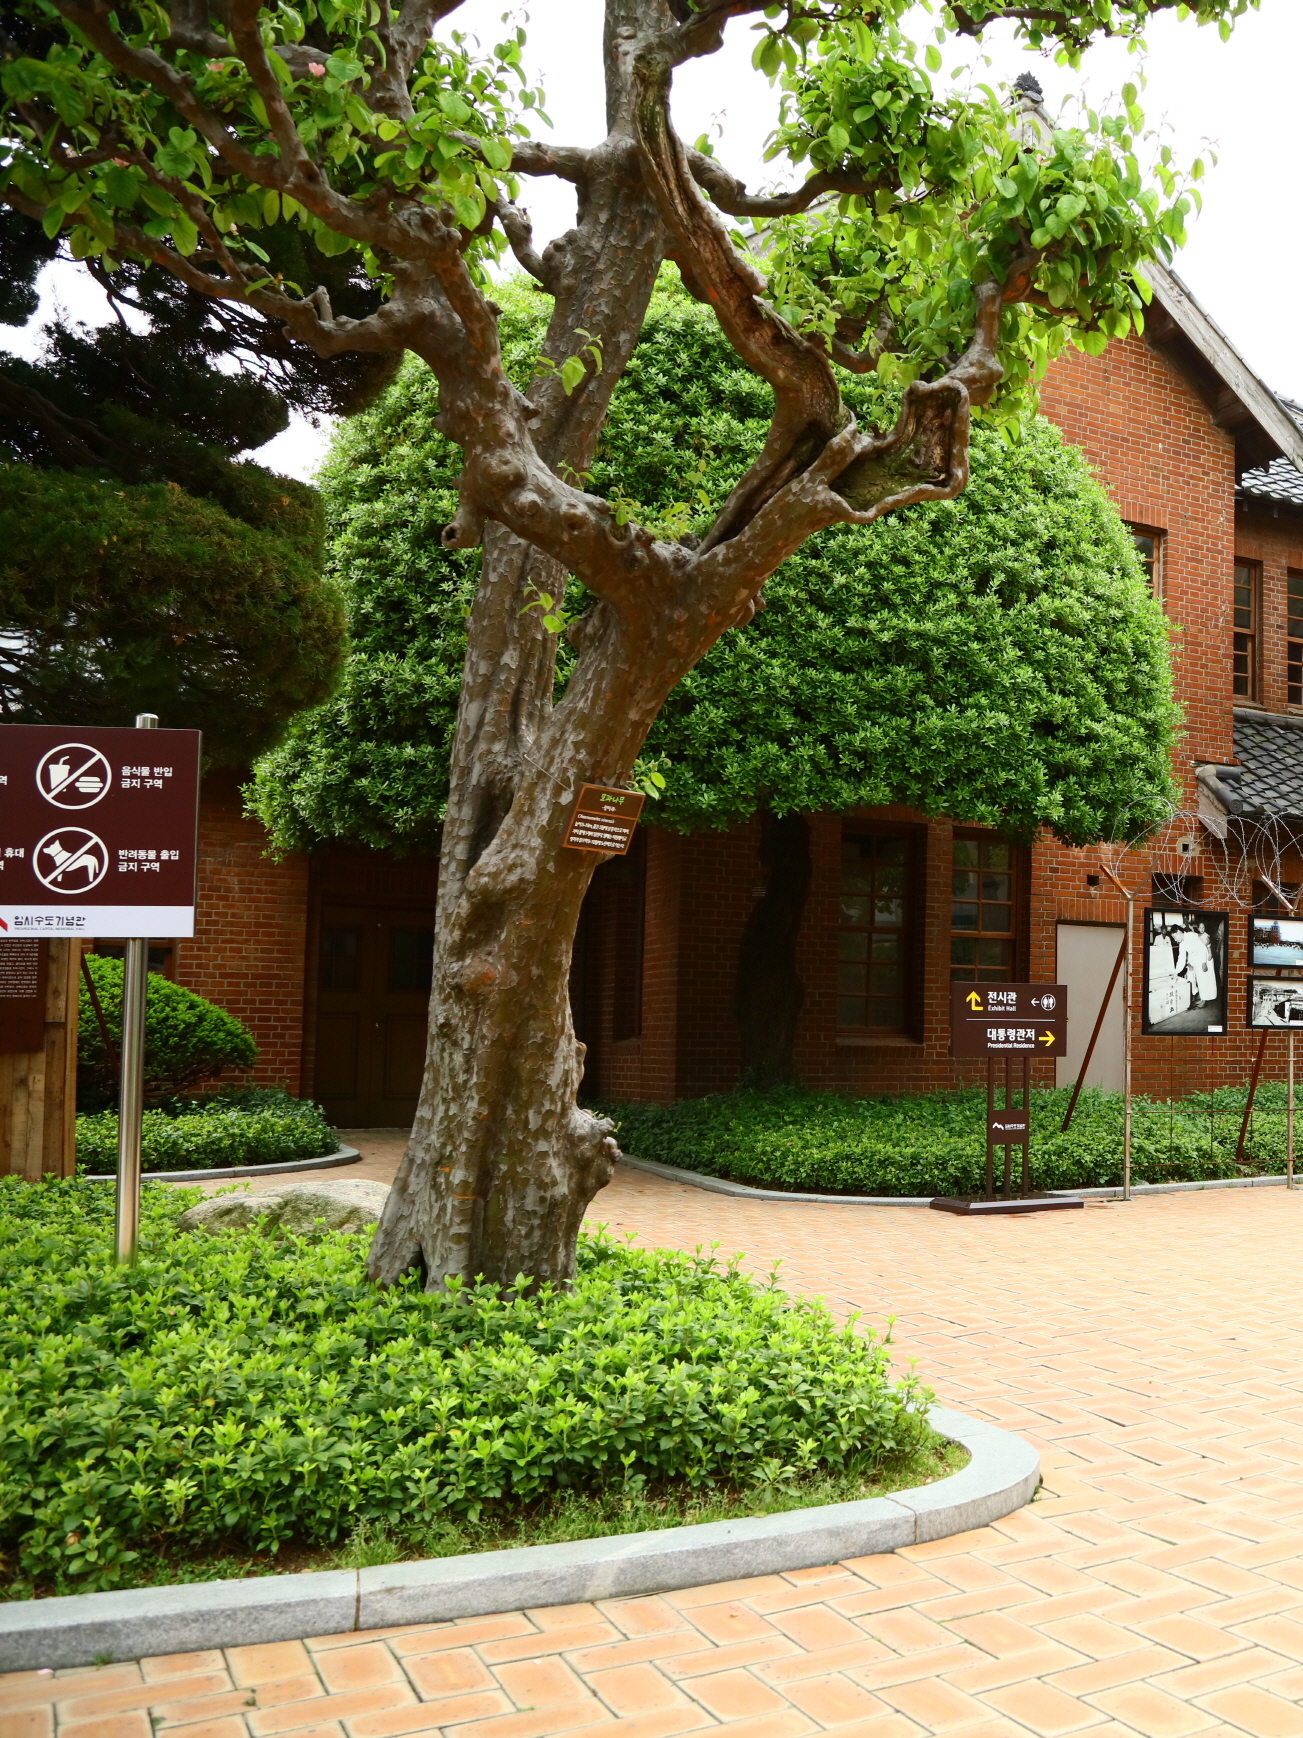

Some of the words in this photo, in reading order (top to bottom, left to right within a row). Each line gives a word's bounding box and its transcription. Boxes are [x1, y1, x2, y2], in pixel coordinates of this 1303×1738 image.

[121, 766, 150, 777] 음식물
[153, 766, 173, 777] 반입
[121, 778, 141, 788] 금지
[143, 779, 163, 789] 구역
[600, 793, 626, 805] 모과나무
[3, 847, 25, 858] 휴대
[118, 850, 157, 860] 반려동물
[160, 850, 179, 860] 출입
[118, 862, 138, 872] 금지
[140, 862, 160, 872] 구역
[14, 915, 87, 926] 임시수도기념관
[987, 991, 1018, 1004] 전시관
[987, 1028, 1035, 1041] 대통령관저
